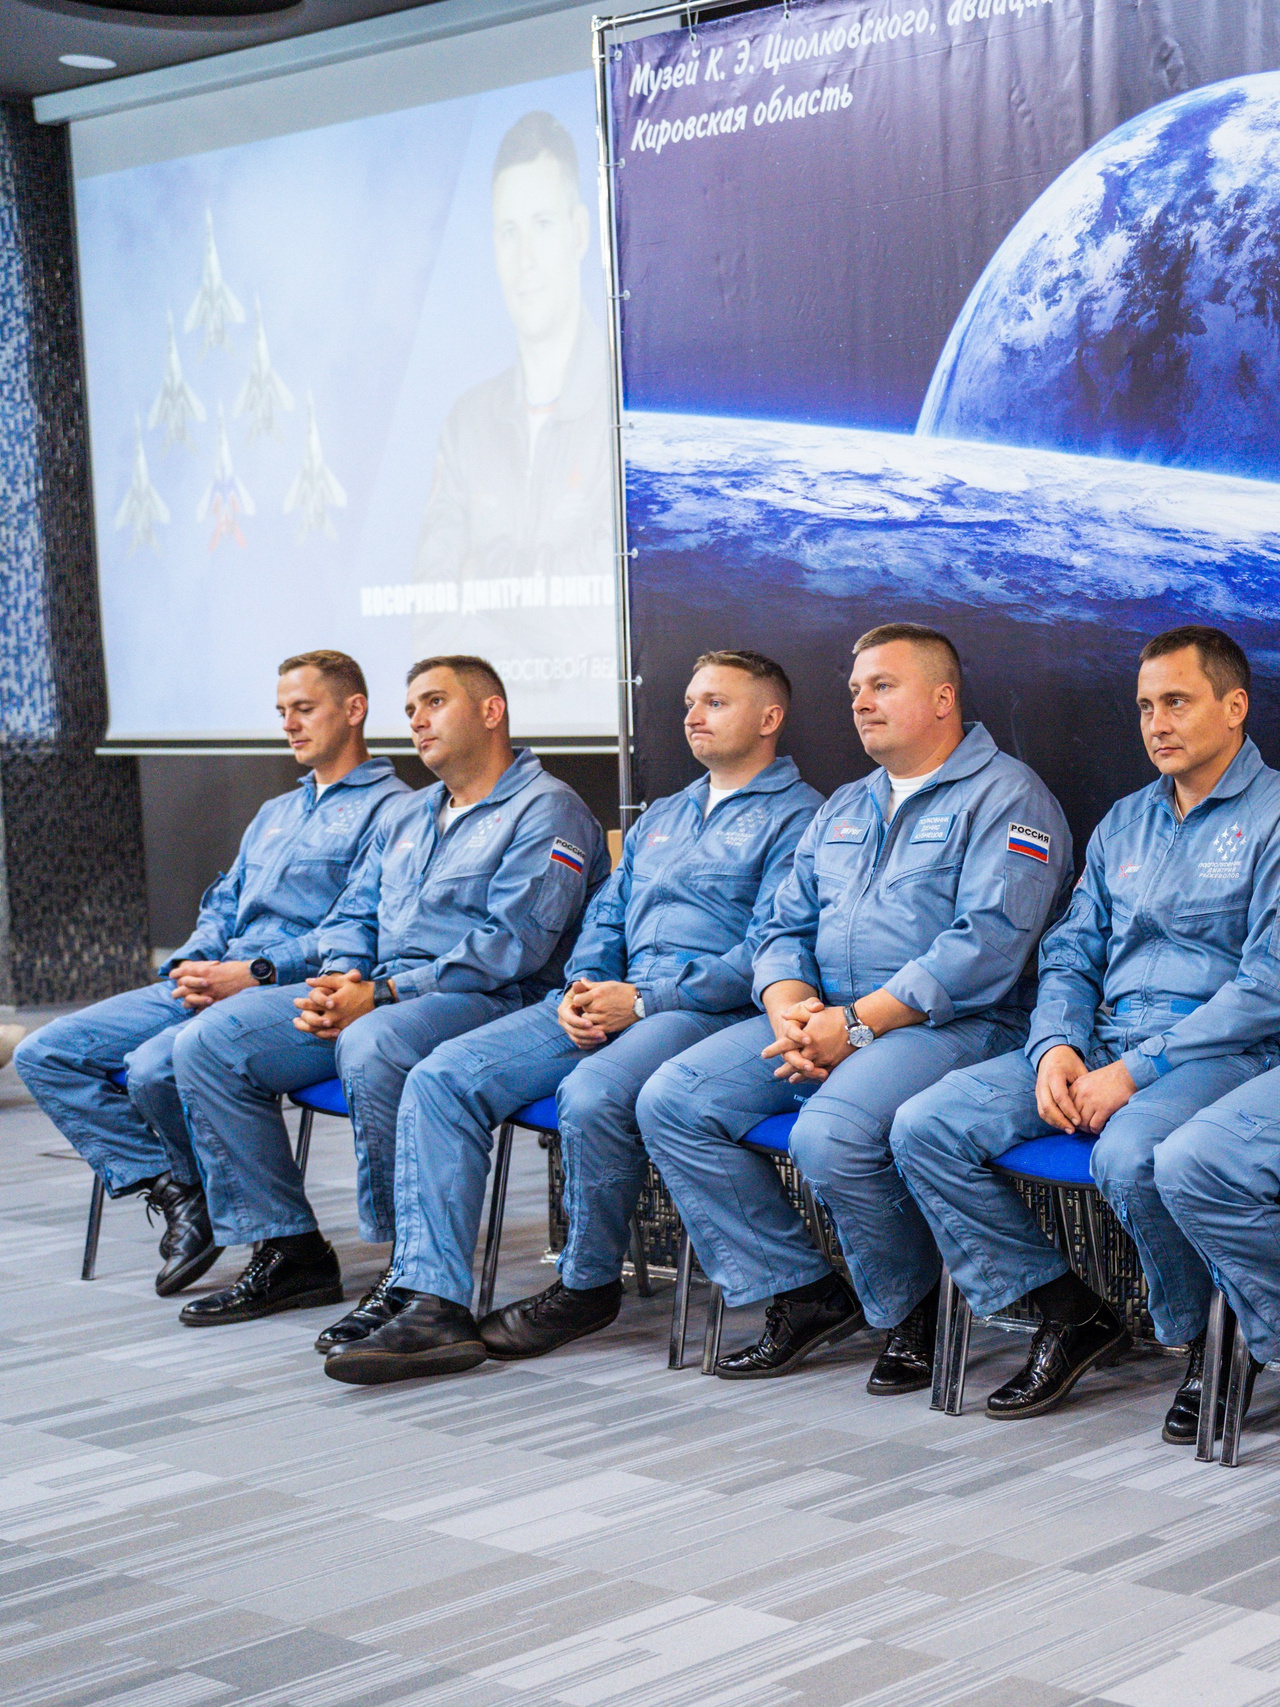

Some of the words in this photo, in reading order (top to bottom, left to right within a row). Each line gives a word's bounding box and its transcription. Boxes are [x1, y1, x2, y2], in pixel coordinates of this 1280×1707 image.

[629, 49, 701, 103] Музей
[705, 47, 726, 82] К.
[734, 39, 754, 75] Э.
[763, 7, 937, 76] Циолковского,
[947, 0, 1054, 26] авиац
[630, 104, 748, 154] Кировская
[753, 83, 854, 127] область
[360, 582, 458, 617] КОСОРУКОВ
[461, 571, 546, 616] ДМИТРИЙ
[1011, 824, 1049, 843] РОССИЯ
